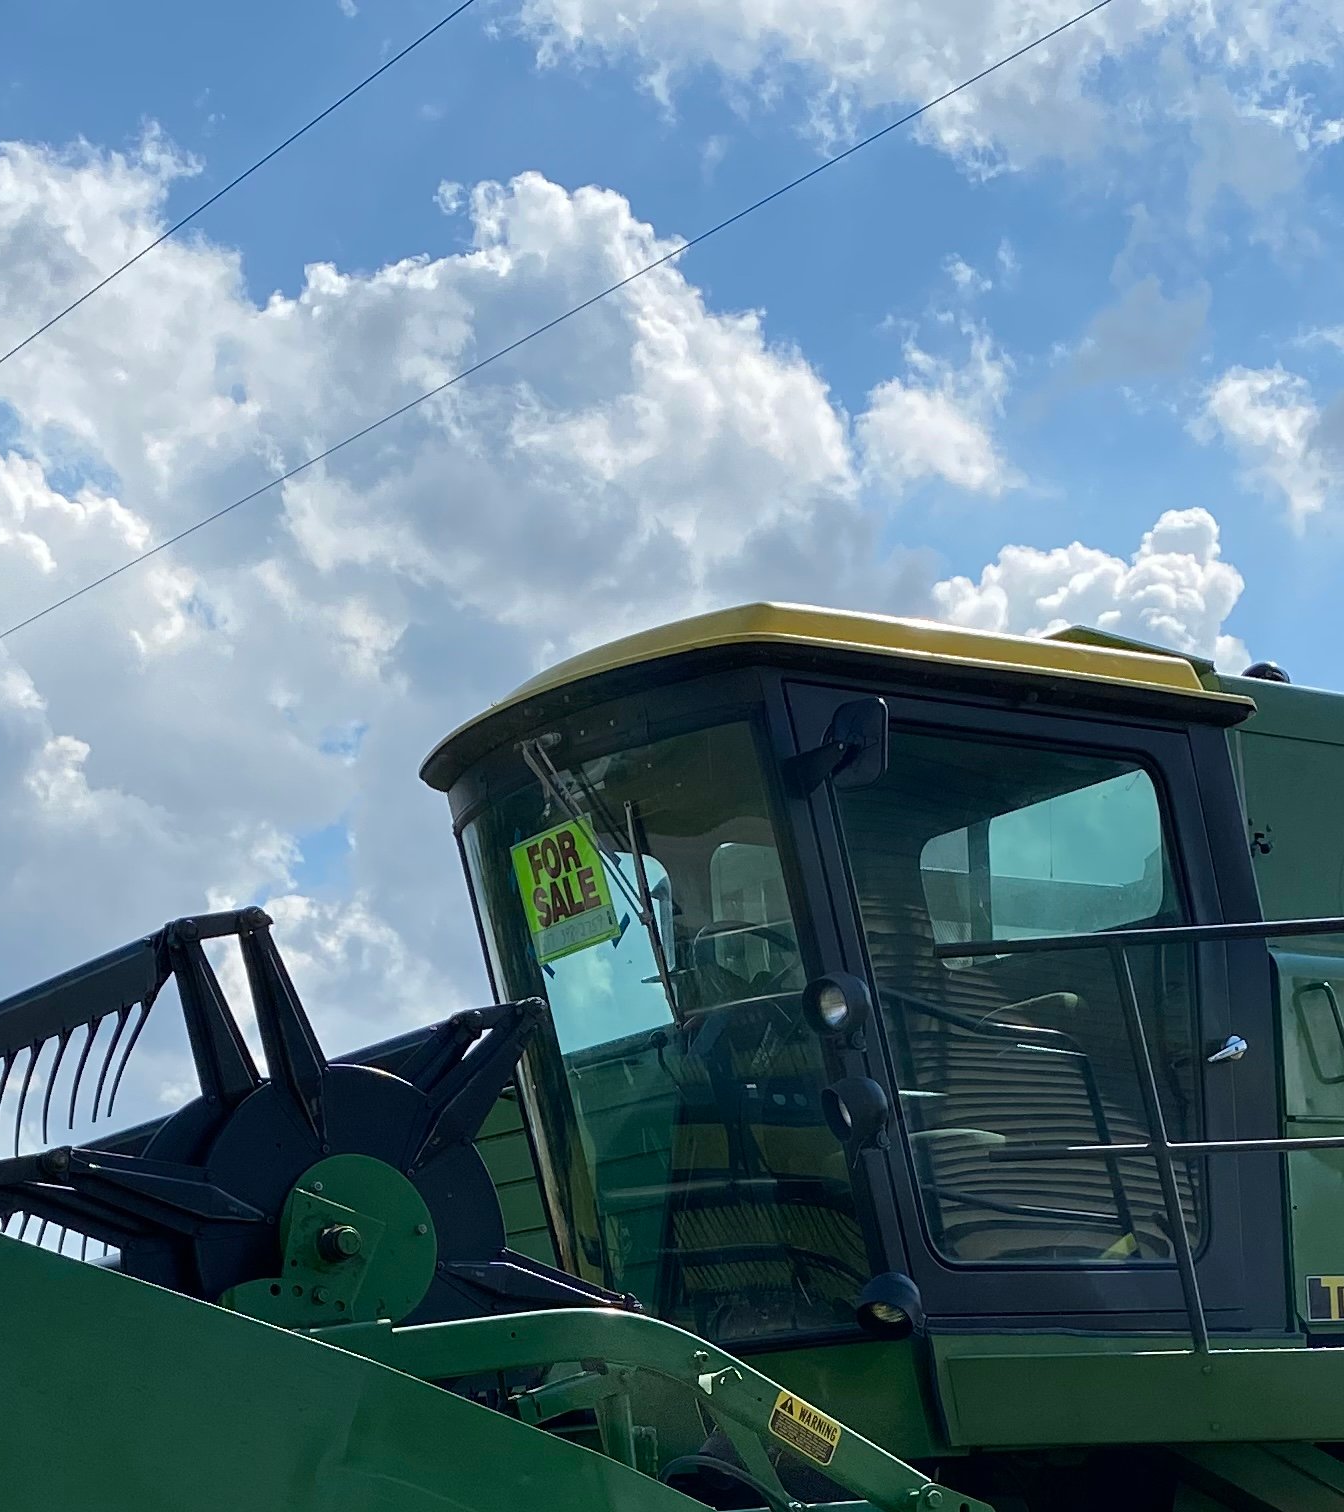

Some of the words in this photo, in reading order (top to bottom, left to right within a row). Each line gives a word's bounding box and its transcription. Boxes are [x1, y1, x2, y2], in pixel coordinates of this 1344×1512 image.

[526, 829, 582, 885] FOR
[533, 867, 602, 928] SALE
[798, 1406, 838, 1442] WARNING
